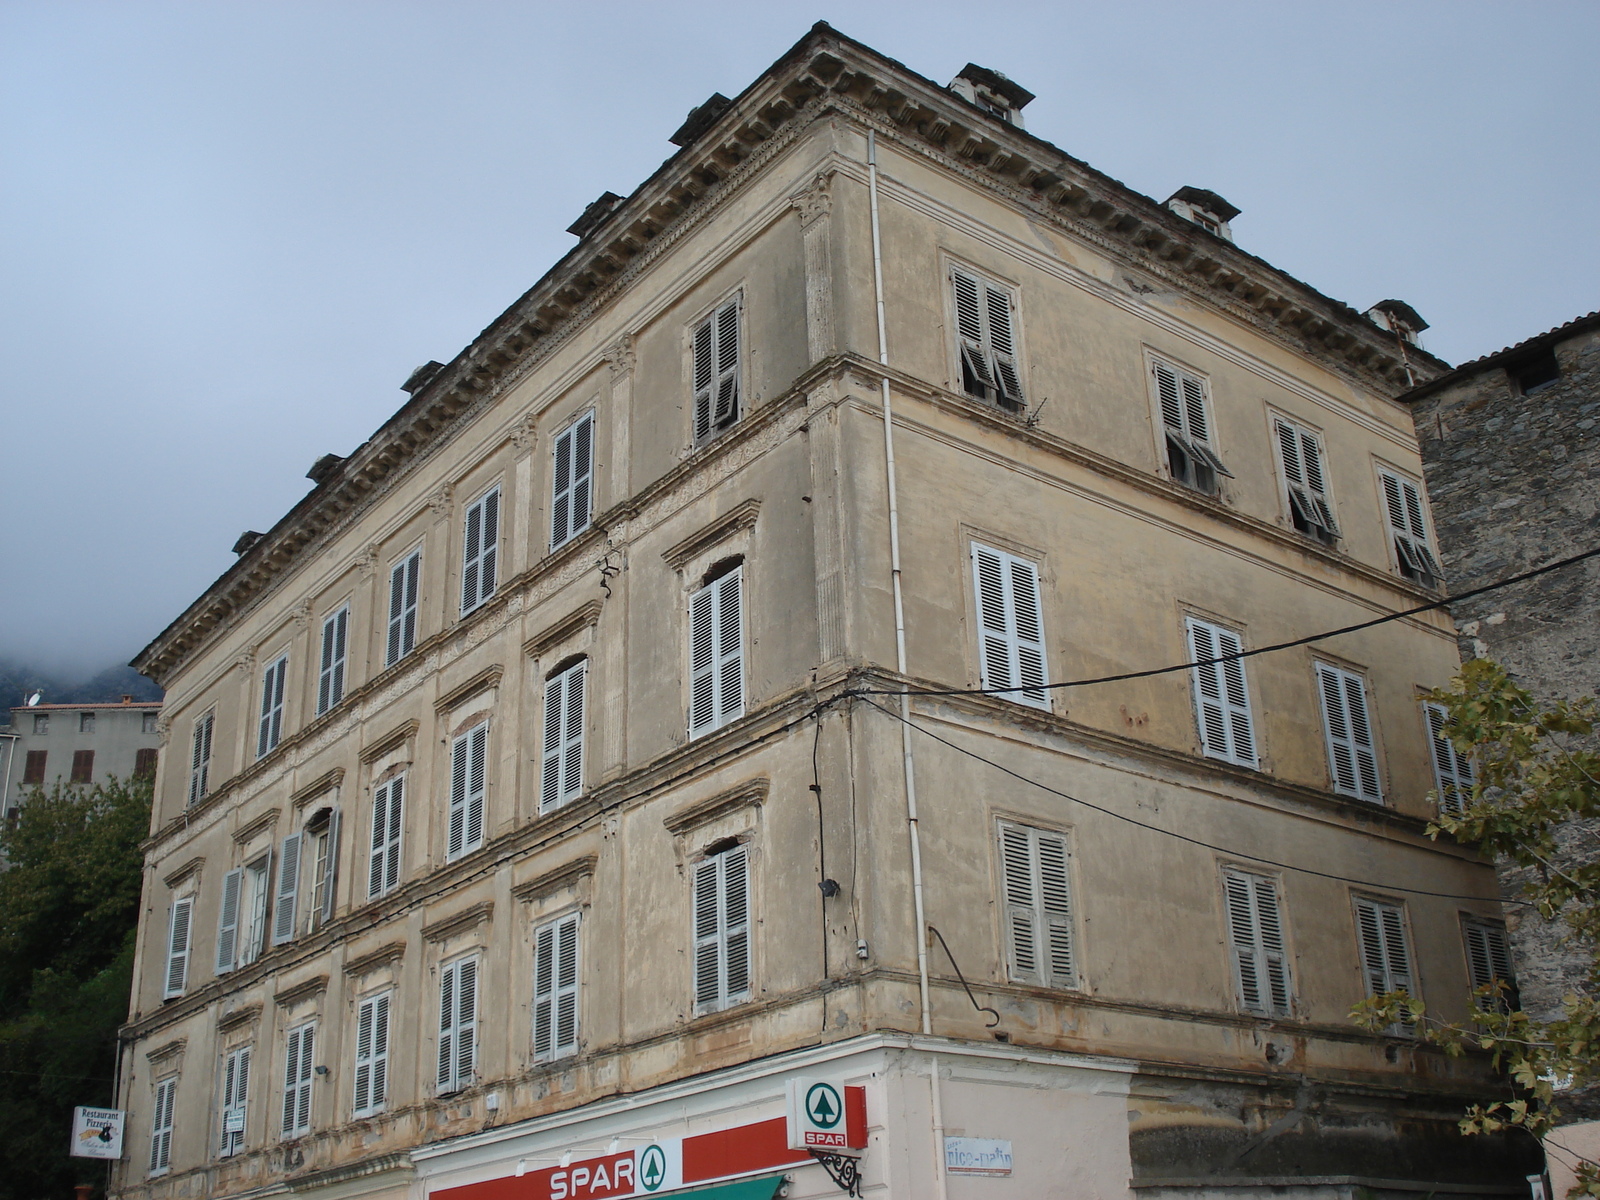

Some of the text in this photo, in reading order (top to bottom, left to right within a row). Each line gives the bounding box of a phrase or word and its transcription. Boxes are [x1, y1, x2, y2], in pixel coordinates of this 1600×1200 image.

[82, 1108, 119, 1120] Restaurant
[86, 1119, 113, 1128] Pizzeria
[806, 1132, 845, 1145] SPAR
[550, 1158, 634, 1200] SPAR
